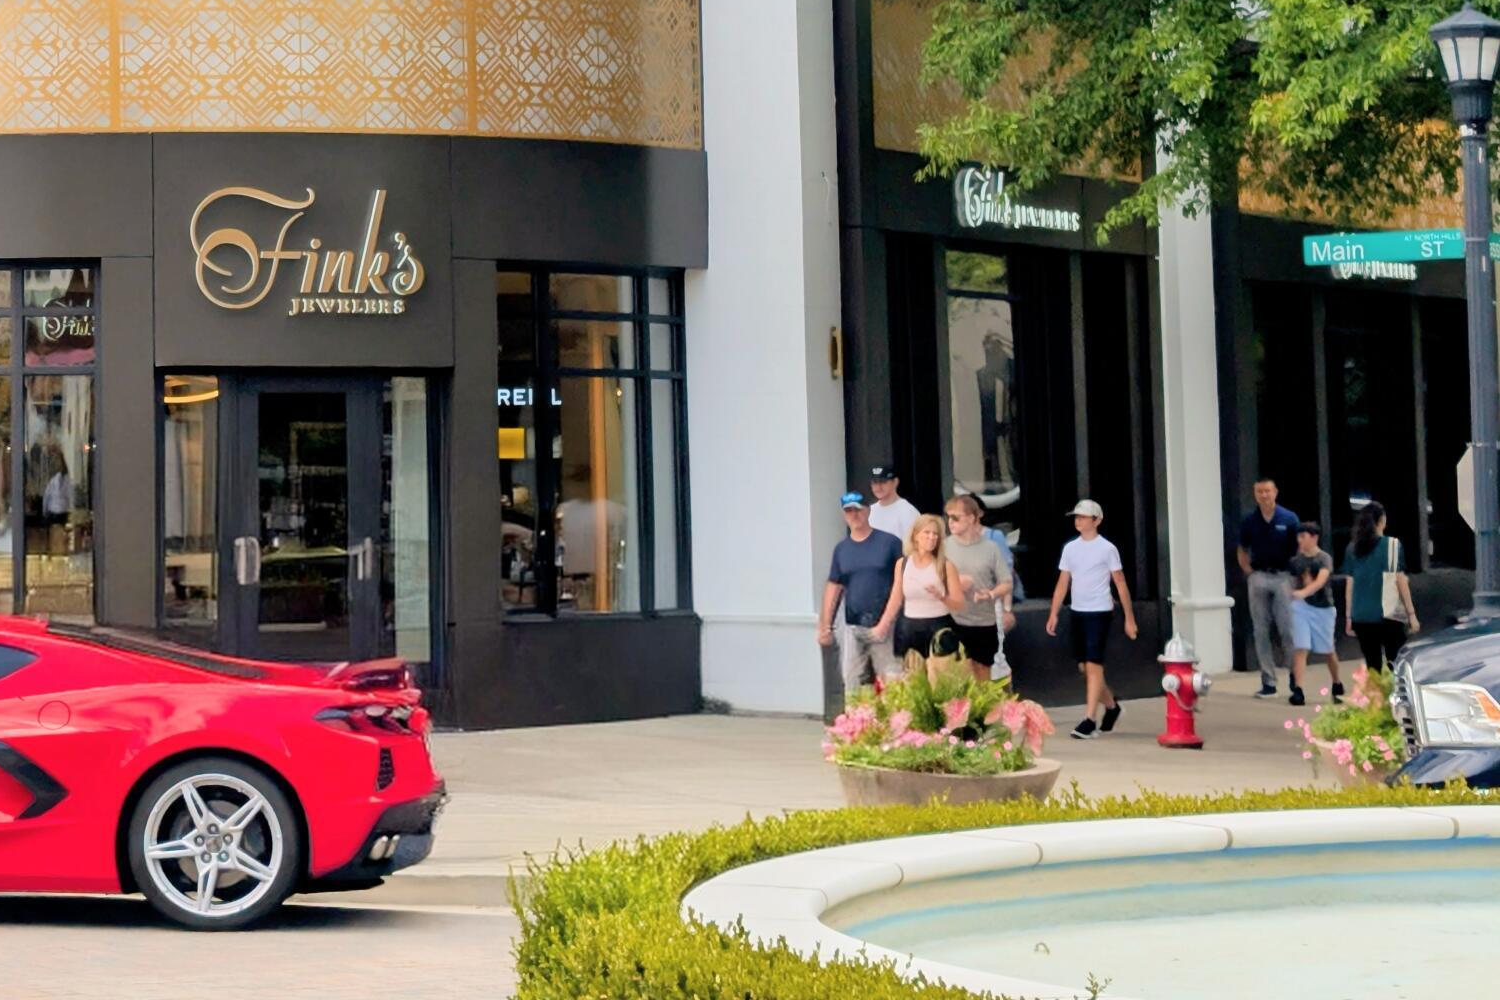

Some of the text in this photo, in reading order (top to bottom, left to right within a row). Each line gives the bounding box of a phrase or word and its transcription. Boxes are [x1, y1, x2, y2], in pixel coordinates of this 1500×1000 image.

[189, 186, 425, 310] Fink's
[1311, 240, 1445, 263] Main ST
[288, 298, 406, 317] JEWELERS
